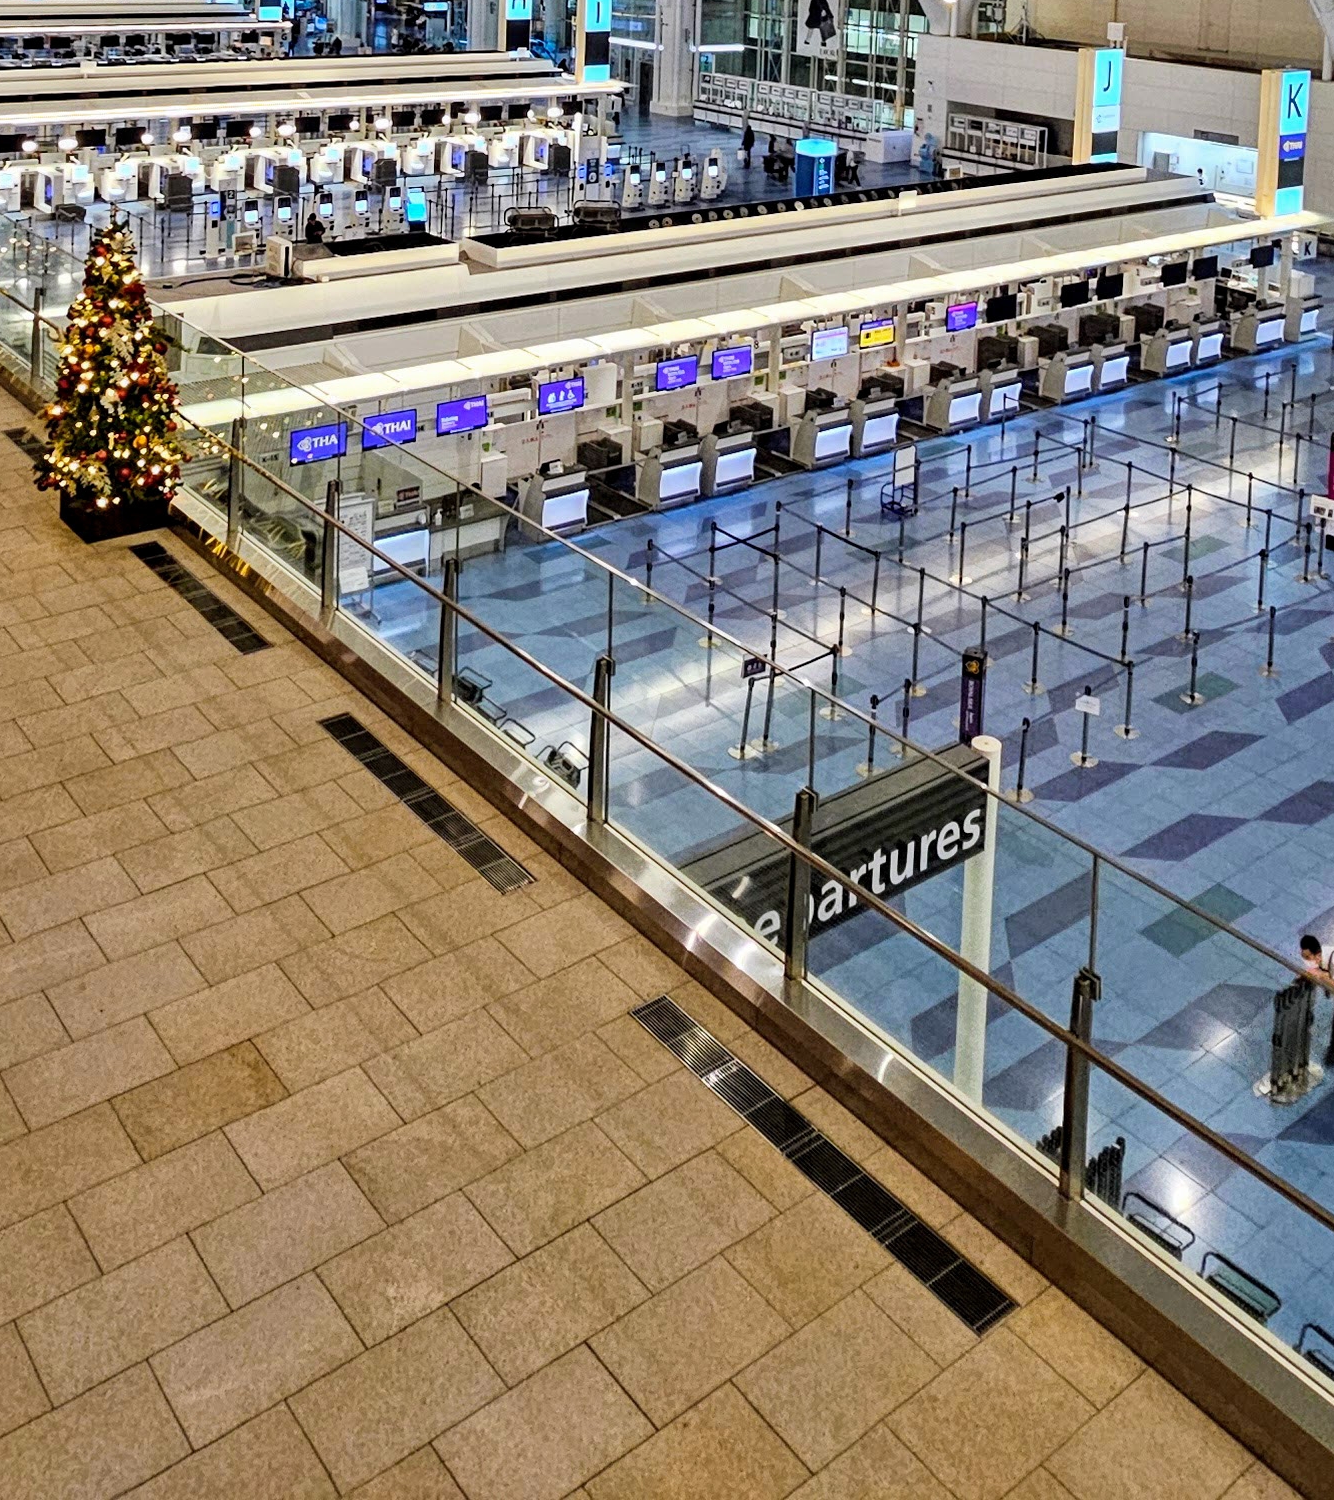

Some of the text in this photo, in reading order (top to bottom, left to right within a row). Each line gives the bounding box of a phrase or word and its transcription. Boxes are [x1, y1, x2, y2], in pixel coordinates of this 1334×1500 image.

[596, 1, 601, 23] I
[1103, 60, 1112, 92] J
[1287, 82, 1304, 119] K
[1304, 240, 1312, 256] K
[384, 419, 412, 434] THAI
[312, 433, 339, 448] THA
[753, 808, 982, 947] eartures
